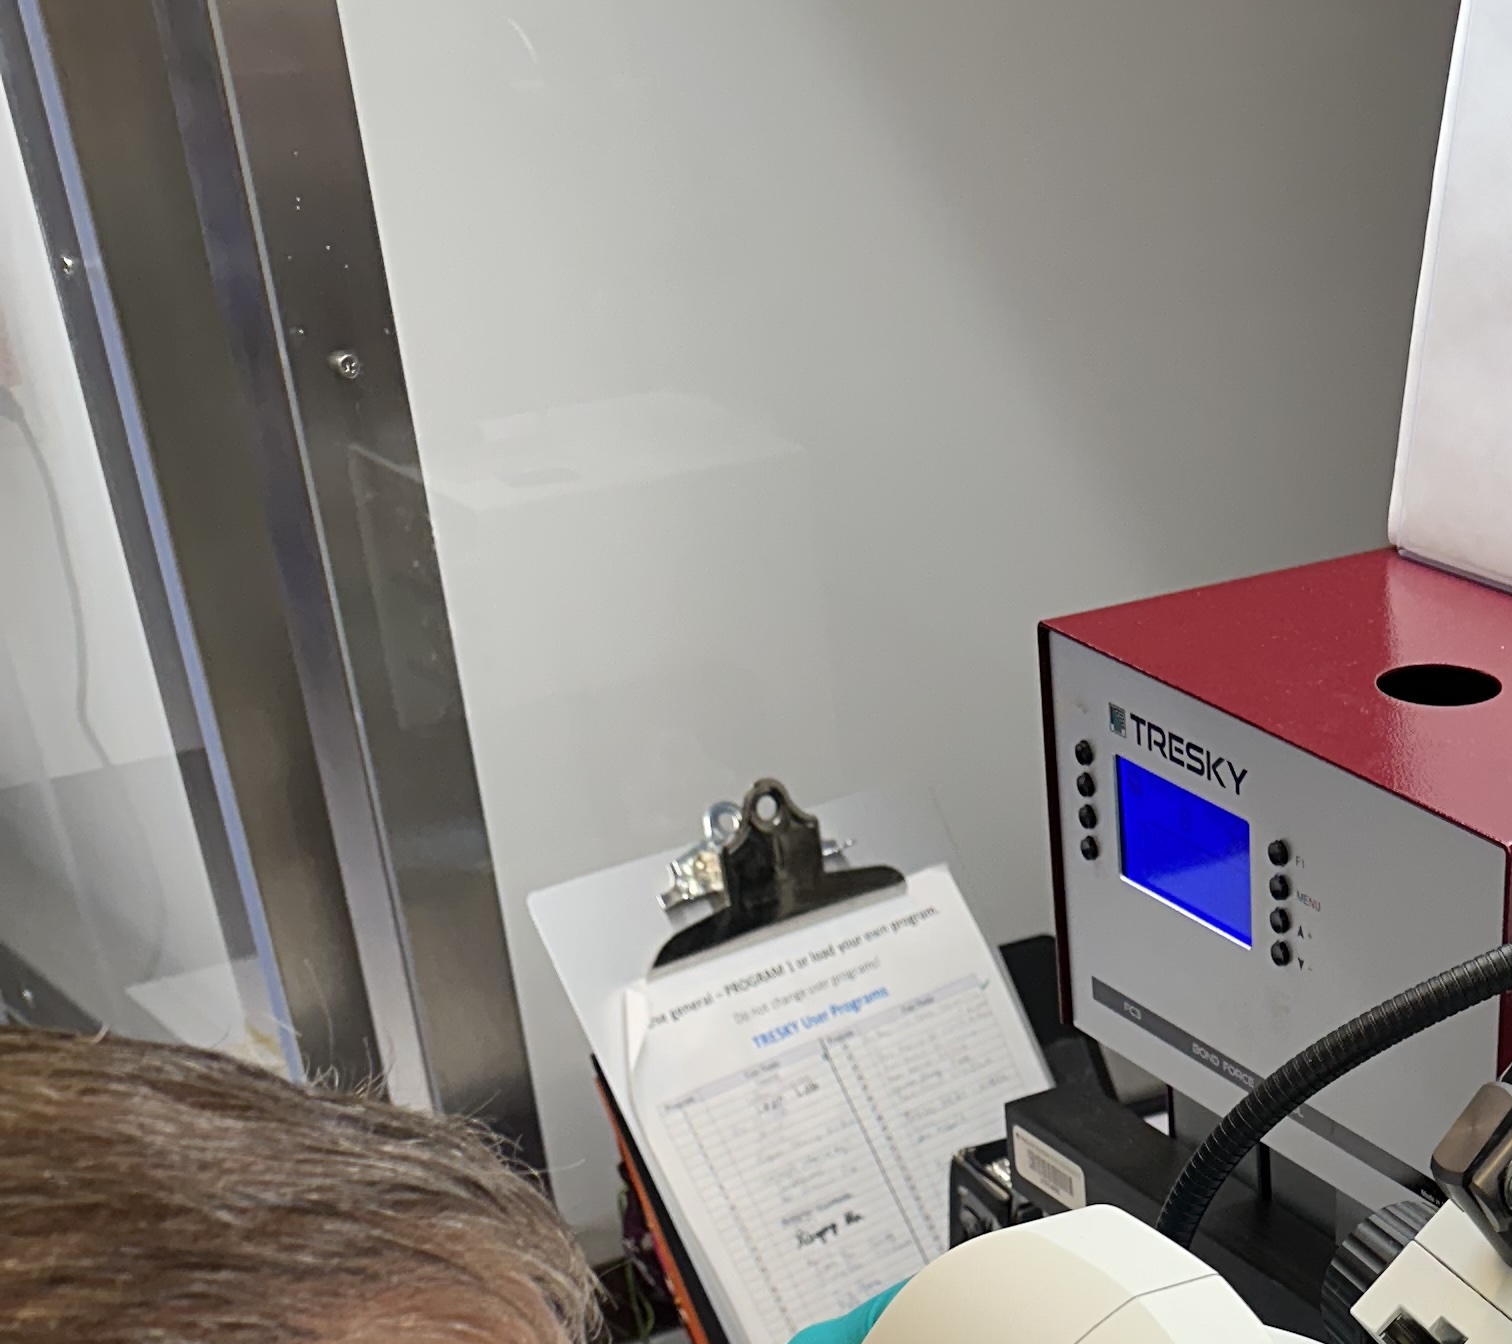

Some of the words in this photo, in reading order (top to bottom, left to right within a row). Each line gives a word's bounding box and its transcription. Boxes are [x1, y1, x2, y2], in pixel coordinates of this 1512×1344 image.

[1130, 712, 1248, 795] TRESKY
[1296, 890, 1321, 912] MENU
[723, 965, 785, 997] PROGRAM
[752, 1023, 800, 1048] TRESKY
[829, 986, 889, 1017] Programs
[1192, 1042, 1220, 1067] BOND
[1222, 1061, 1254, 1088] FORCE
